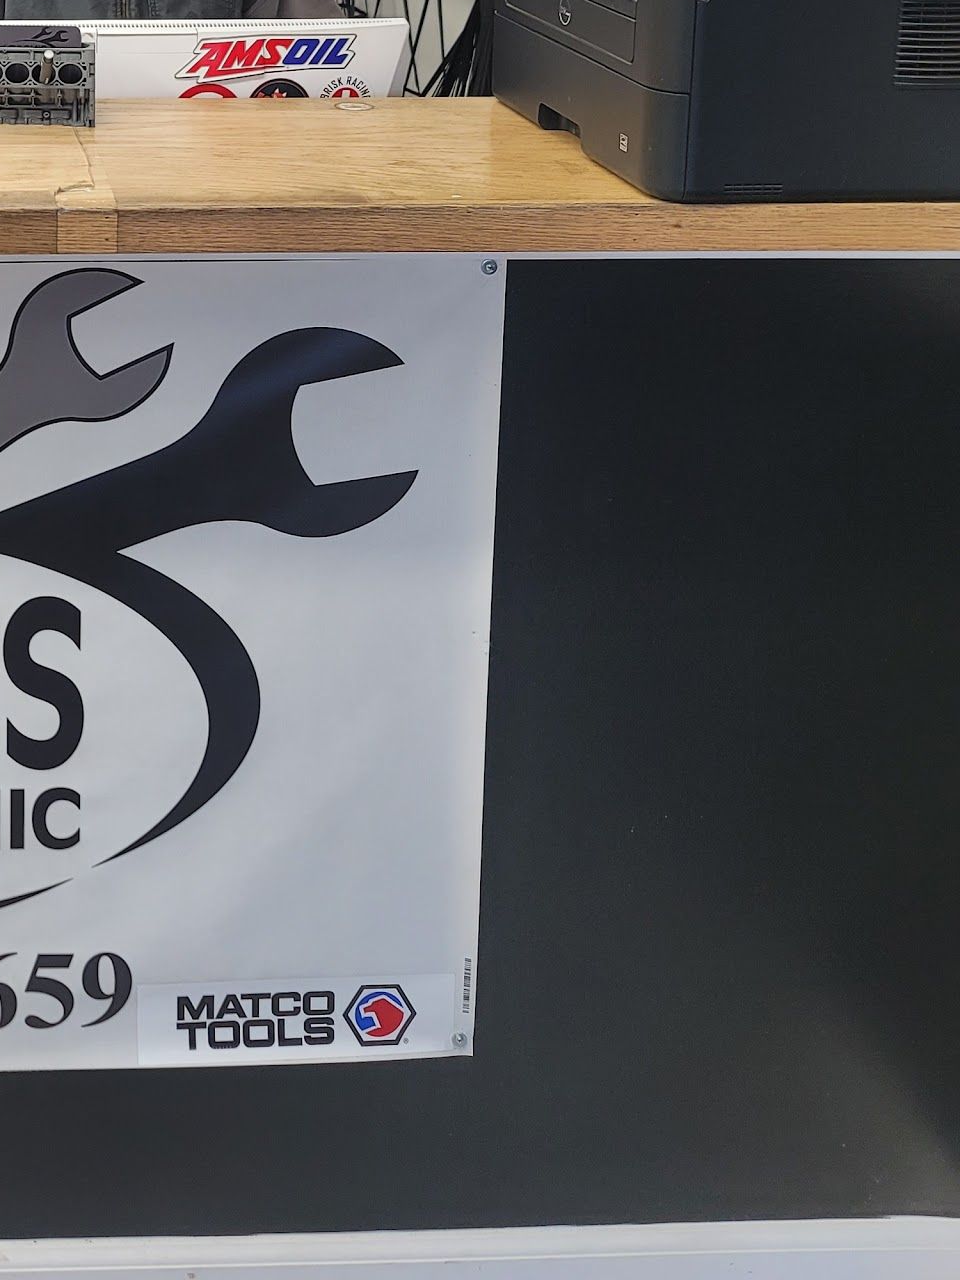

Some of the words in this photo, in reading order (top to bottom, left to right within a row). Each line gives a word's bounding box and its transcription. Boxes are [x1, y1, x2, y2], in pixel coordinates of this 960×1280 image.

[186, 38, 350, 79] AMSOIL
[320, 76, 343, 98] BRISK
[346, 75, 371, 98] RACIN
[176, 990, 336, 1021] MATCO
[176, 1016, 336, 1051] TOOLS
